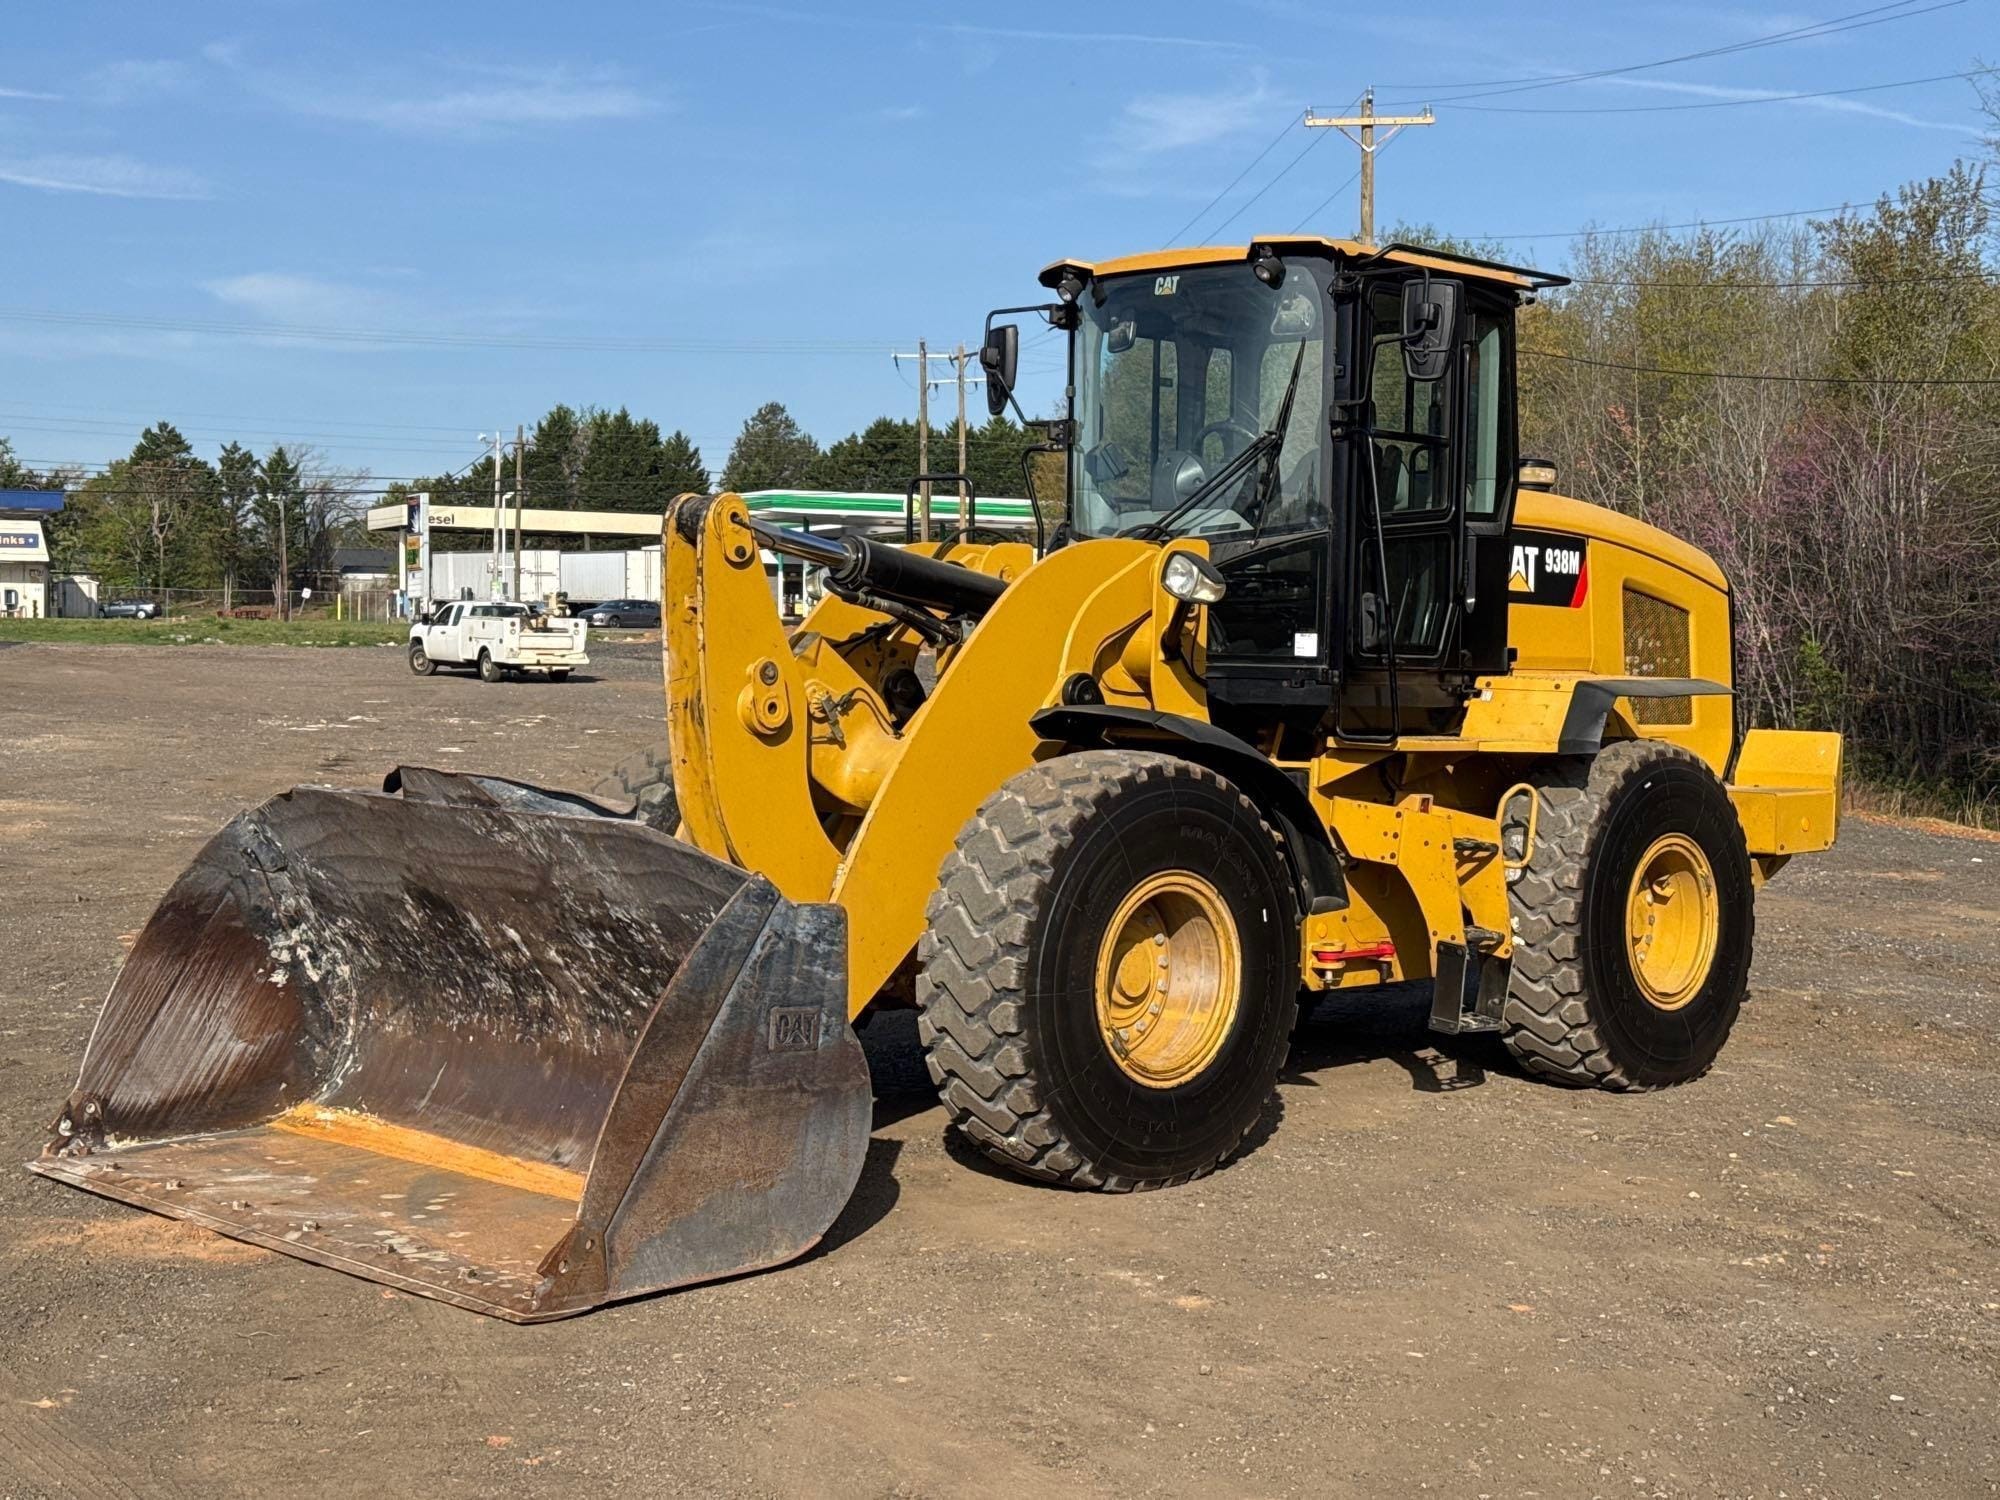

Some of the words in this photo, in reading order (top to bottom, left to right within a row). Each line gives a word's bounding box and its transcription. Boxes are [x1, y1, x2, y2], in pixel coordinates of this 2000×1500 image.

[1154, 276, 1180, 295] CAT
[1508, 546, 1539, 592] AT
[1545, 548, 1580, 575] 938M
[776, 1012, 818, 1046] CAT
